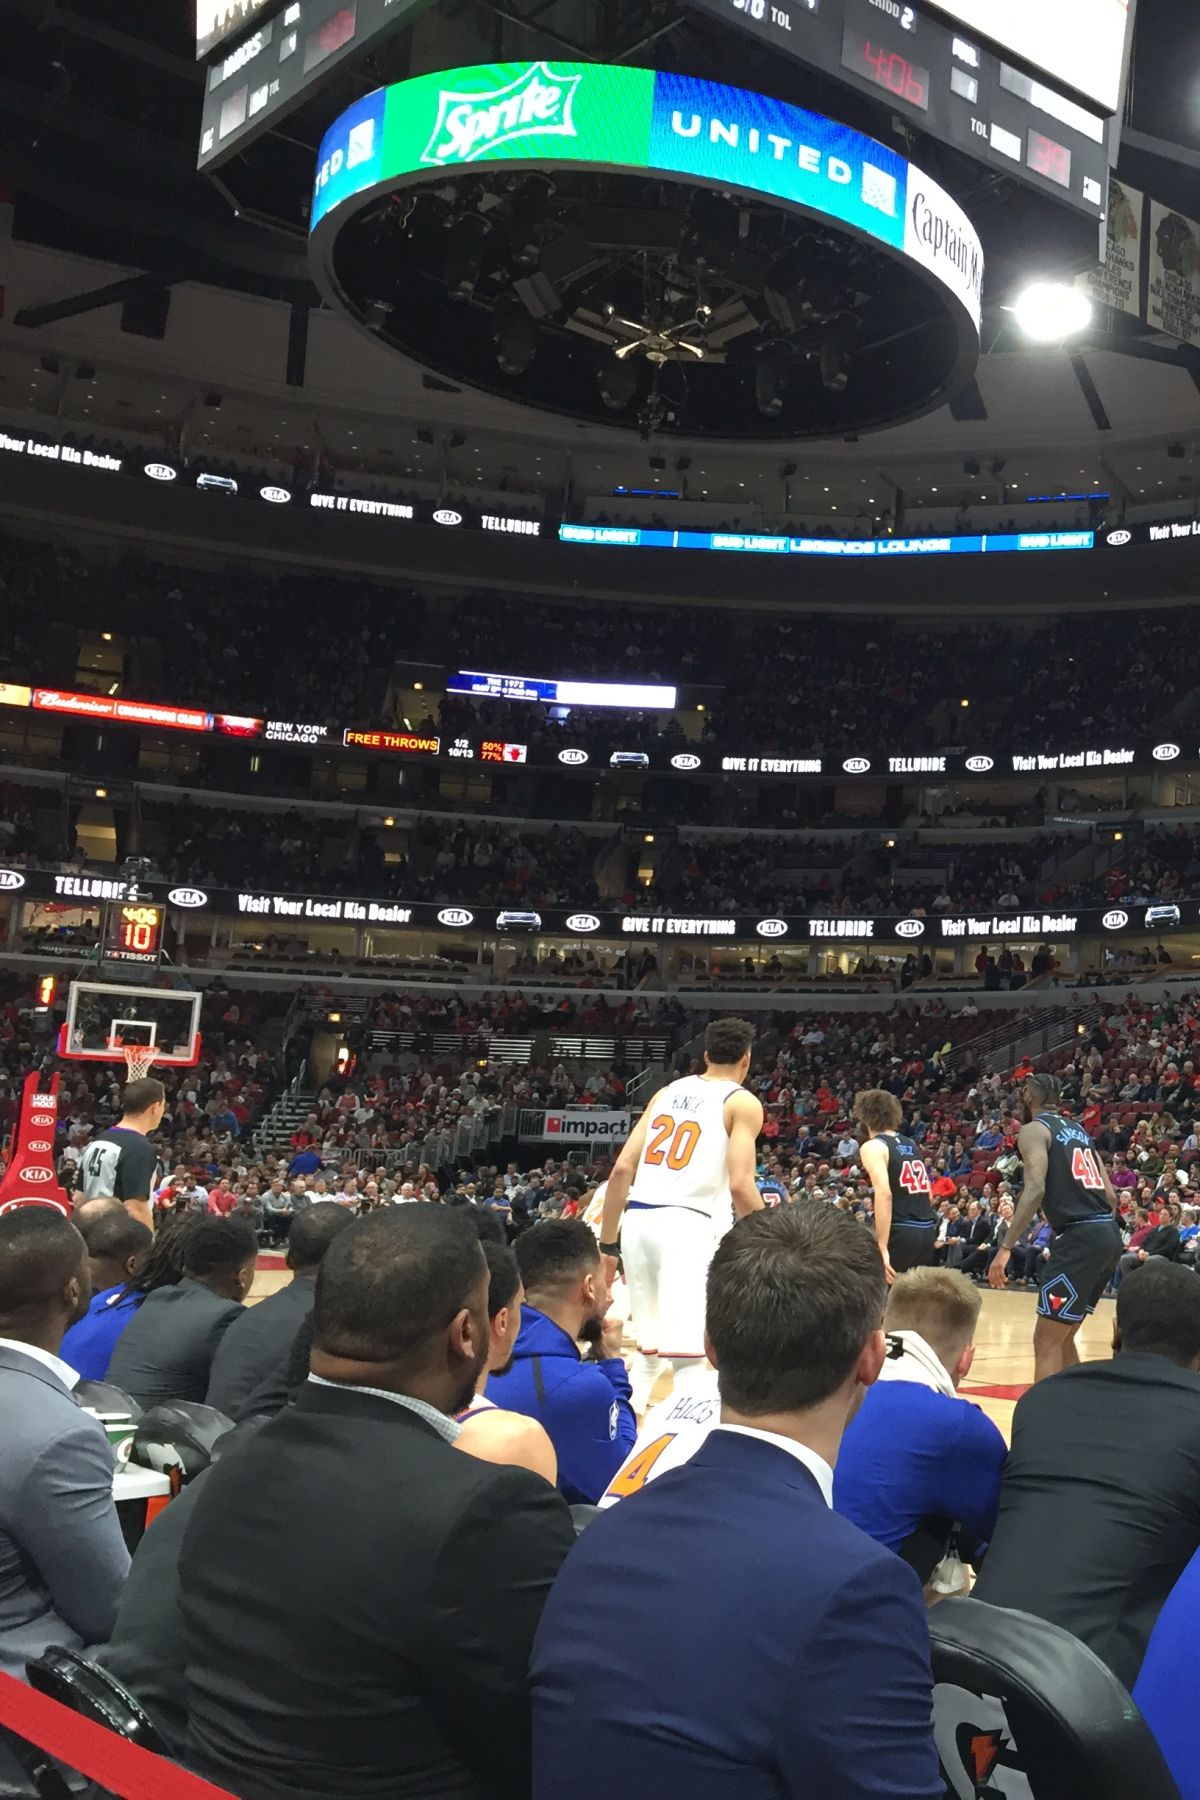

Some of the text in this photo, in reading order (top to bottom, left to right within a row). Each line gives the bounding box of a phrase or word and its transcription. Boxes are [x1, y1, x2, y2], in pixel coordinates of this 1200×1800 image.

[771, 6, 792, 32] TOL
[863, 40, 924, 105] 4:06
[437, 75, 561, 158] Sprite
[970, 117, 989, 140] TOL
[671, 110, 853, 185] UNITED
[912, 193, 968, 277] Captain
[27, 440, 59, 458] Local
[61, 446, 81, 463] Kia
[83, 451, 121, 470] Dealer
[311, 494, 413, 518] GIVE IT EVERYTHING
[482, 516, 540, 535] TELLURIDE
[1150, 526, 1170, 540] Visit
[1171, 524, 1191, 537] Your
[878, 538, 951, 554] LOUNGE
[38, 691, 113, 714] Budweiser
[265, 731, 318, 744] CHICAGO
[267, 721, 328, 736] NEW YORK
[347, 733, 439, 751] FREE THROWS
[454, 738, 469, 749] 1/2
[483, 742, 502, 752] 50%
[481, 751, 502, 761] 77%
[722, 757, 821, 772] GIVE IT EVERYTHING
[889, 757, 946, 772] TELLURIDE
[1013, 749, 1134, 770] Visit Your Local Kia Dealer
[122, 907, 158, 925] 4:06
[239, 894, 411, 922] Visit Your Local Kia Dealer
[622, 917, 735, 934] GIVE IT EVERYTHING
[809, 920, 874, 936] TELLURIDE
[942, 915, 1077, 936] Visit Your Local Kia Dealer
[125, 924, 152, 950] 10
[121, 951, 157, 962] TISSOT
[561, 1115, 628, 1137] impact
[644, 1114, 702, 1171] 20
[88, 1147, 107, 1177] 45
[1072, 1148, 1105, 1190] 41
[900, 1160, 931, 1194] 42
[604, 1433, 679, 1498] 4
